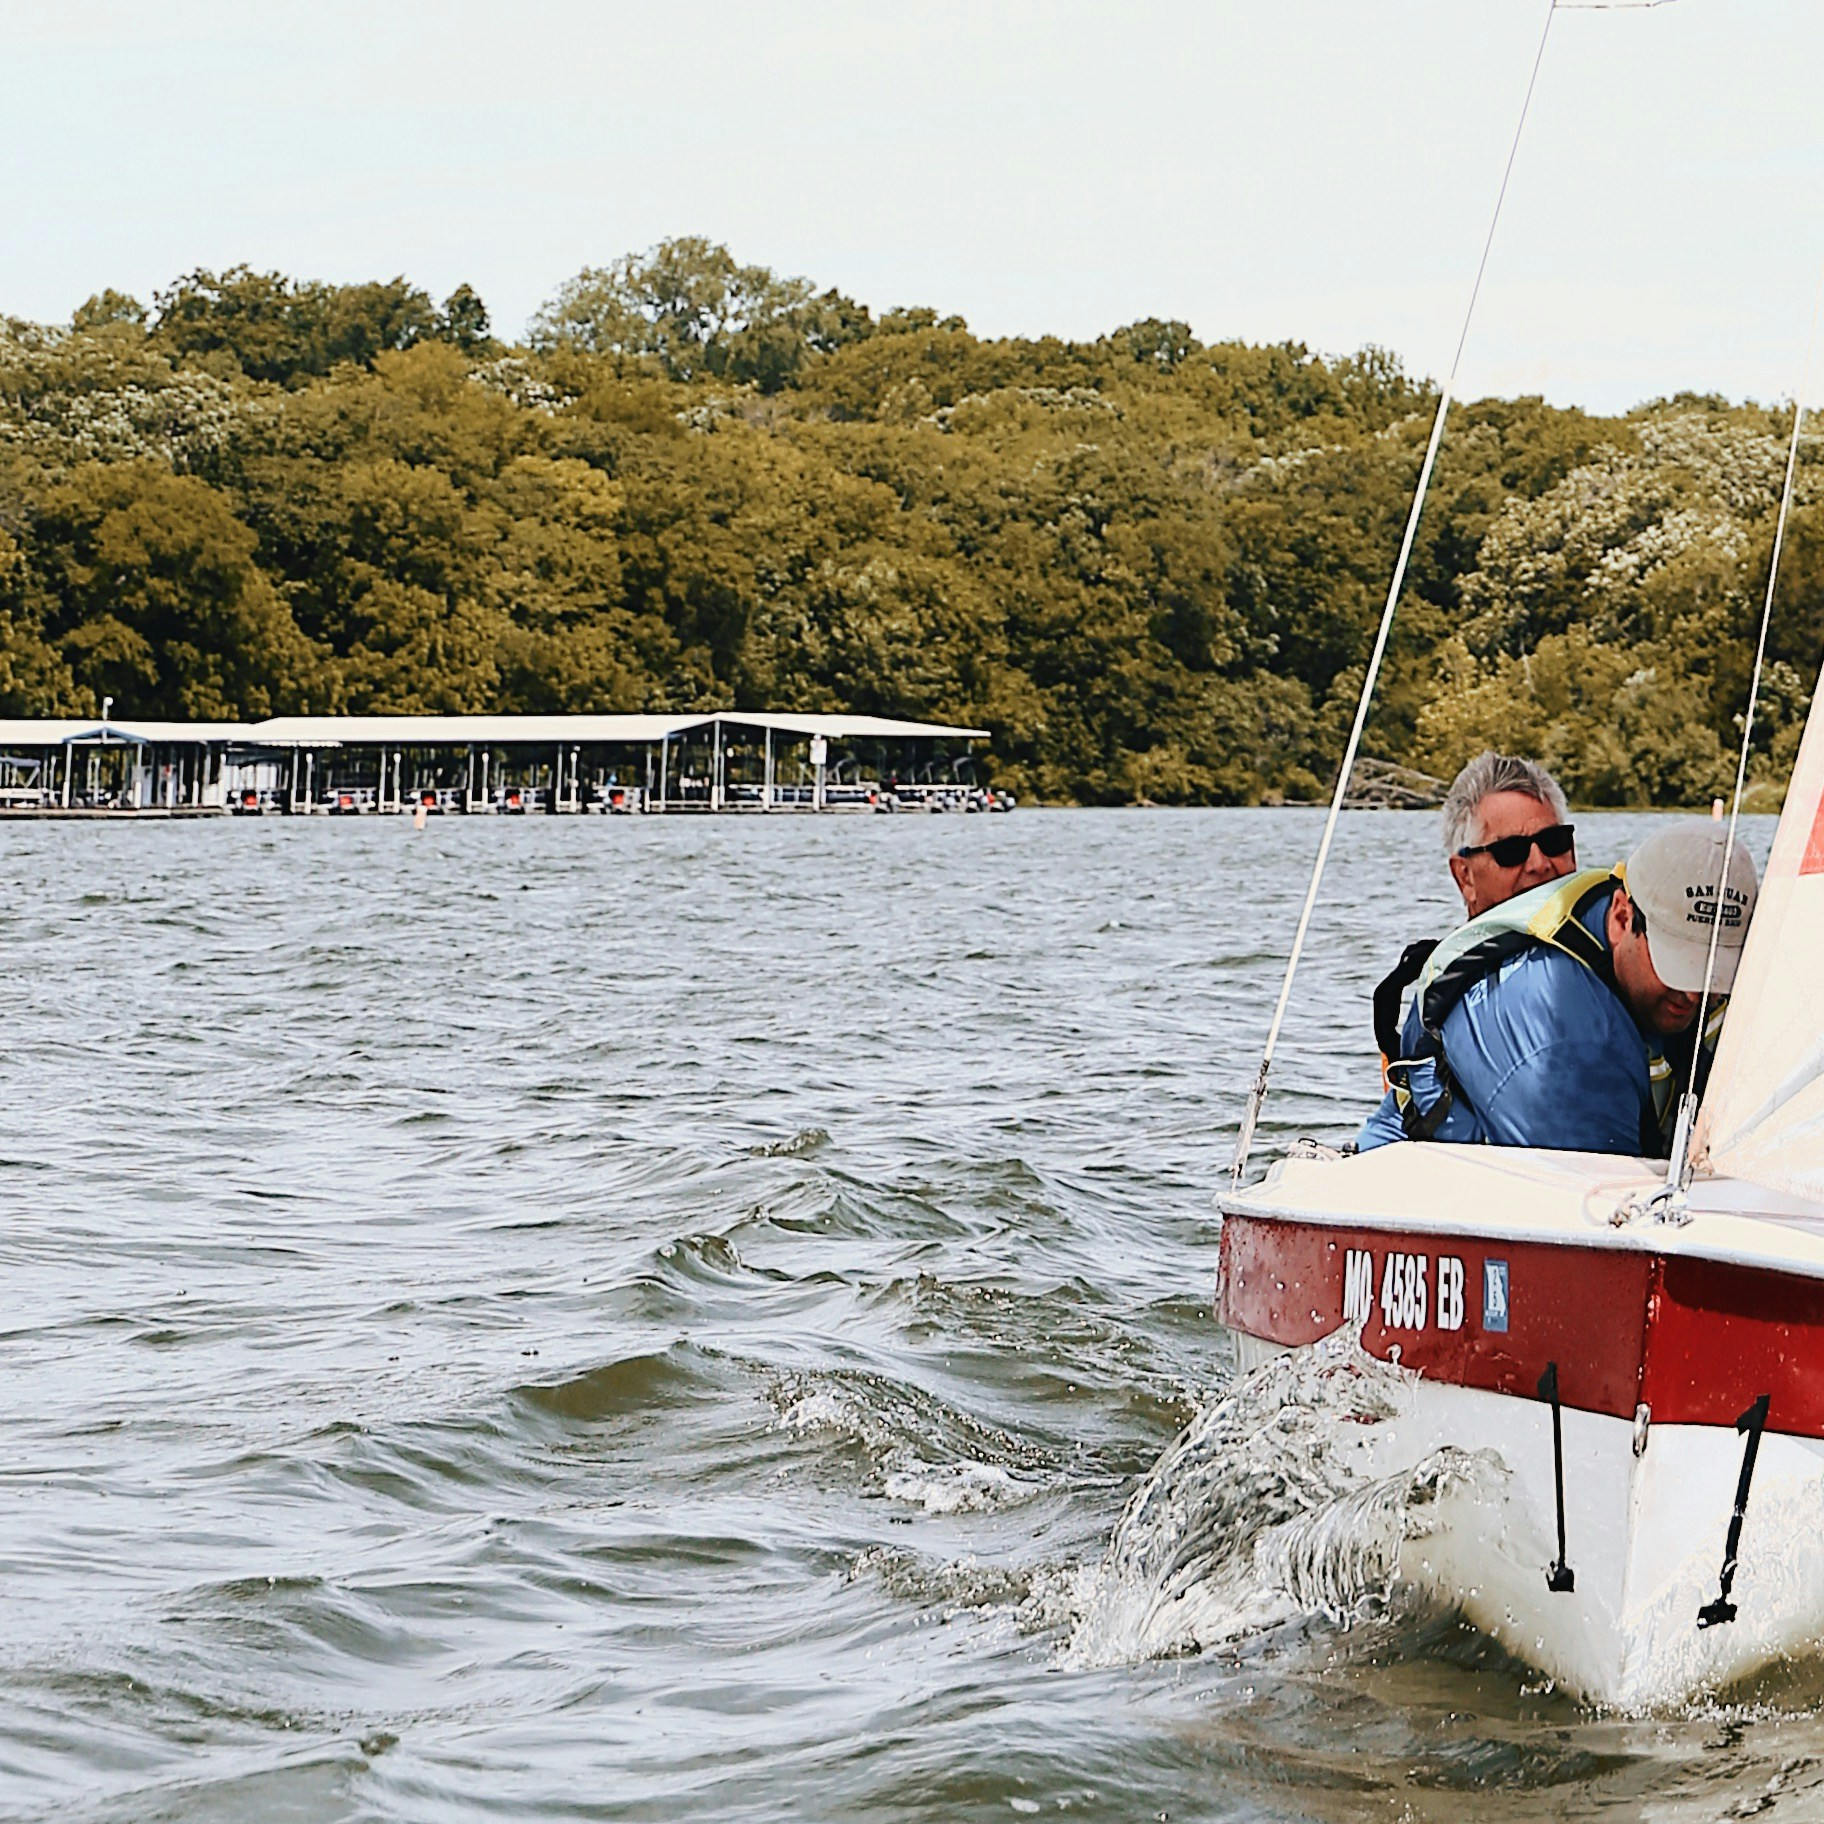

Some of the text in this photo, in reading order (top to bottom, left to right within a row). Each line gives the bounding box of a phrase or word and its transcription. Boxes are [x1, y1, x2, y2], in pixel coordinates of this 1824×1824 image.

[1686, 885, 1748, 906] SAN UAN
[1342, 1249, 1465, 1332] MO 4585 EB
